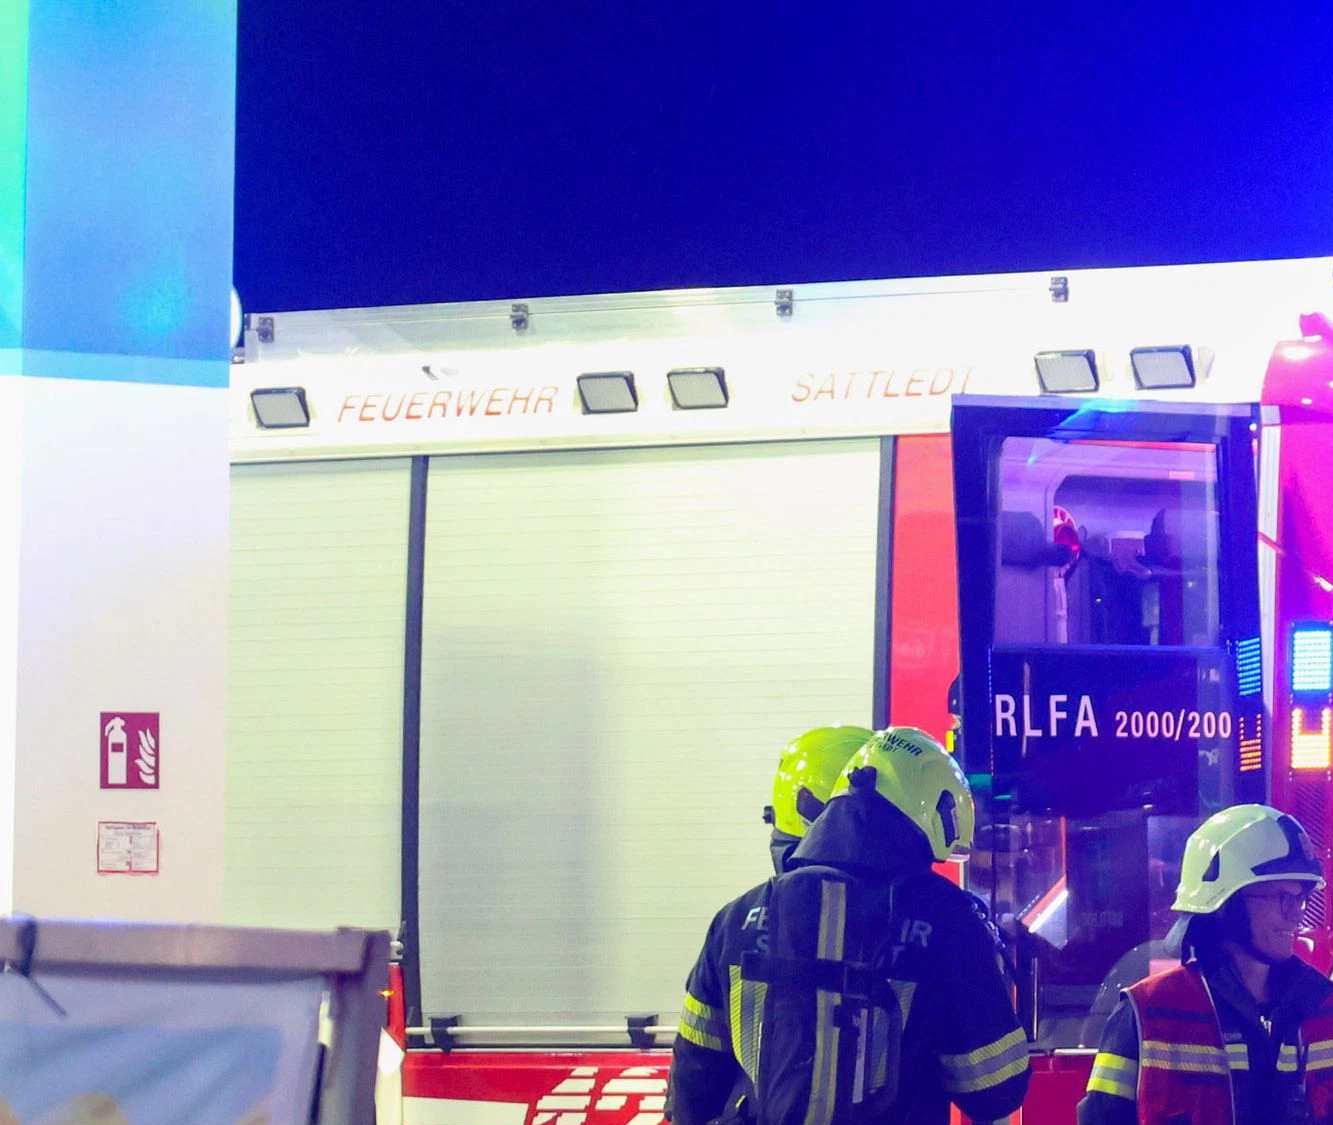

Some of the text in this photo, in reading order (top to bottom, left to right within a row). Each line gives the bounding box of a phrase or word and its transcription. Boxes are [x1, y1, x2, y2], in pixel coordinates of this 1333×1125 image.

[337, 386, 559, 423] FEUERWEHR
[995, 693, 1232, 741] RLFA 2000/200
